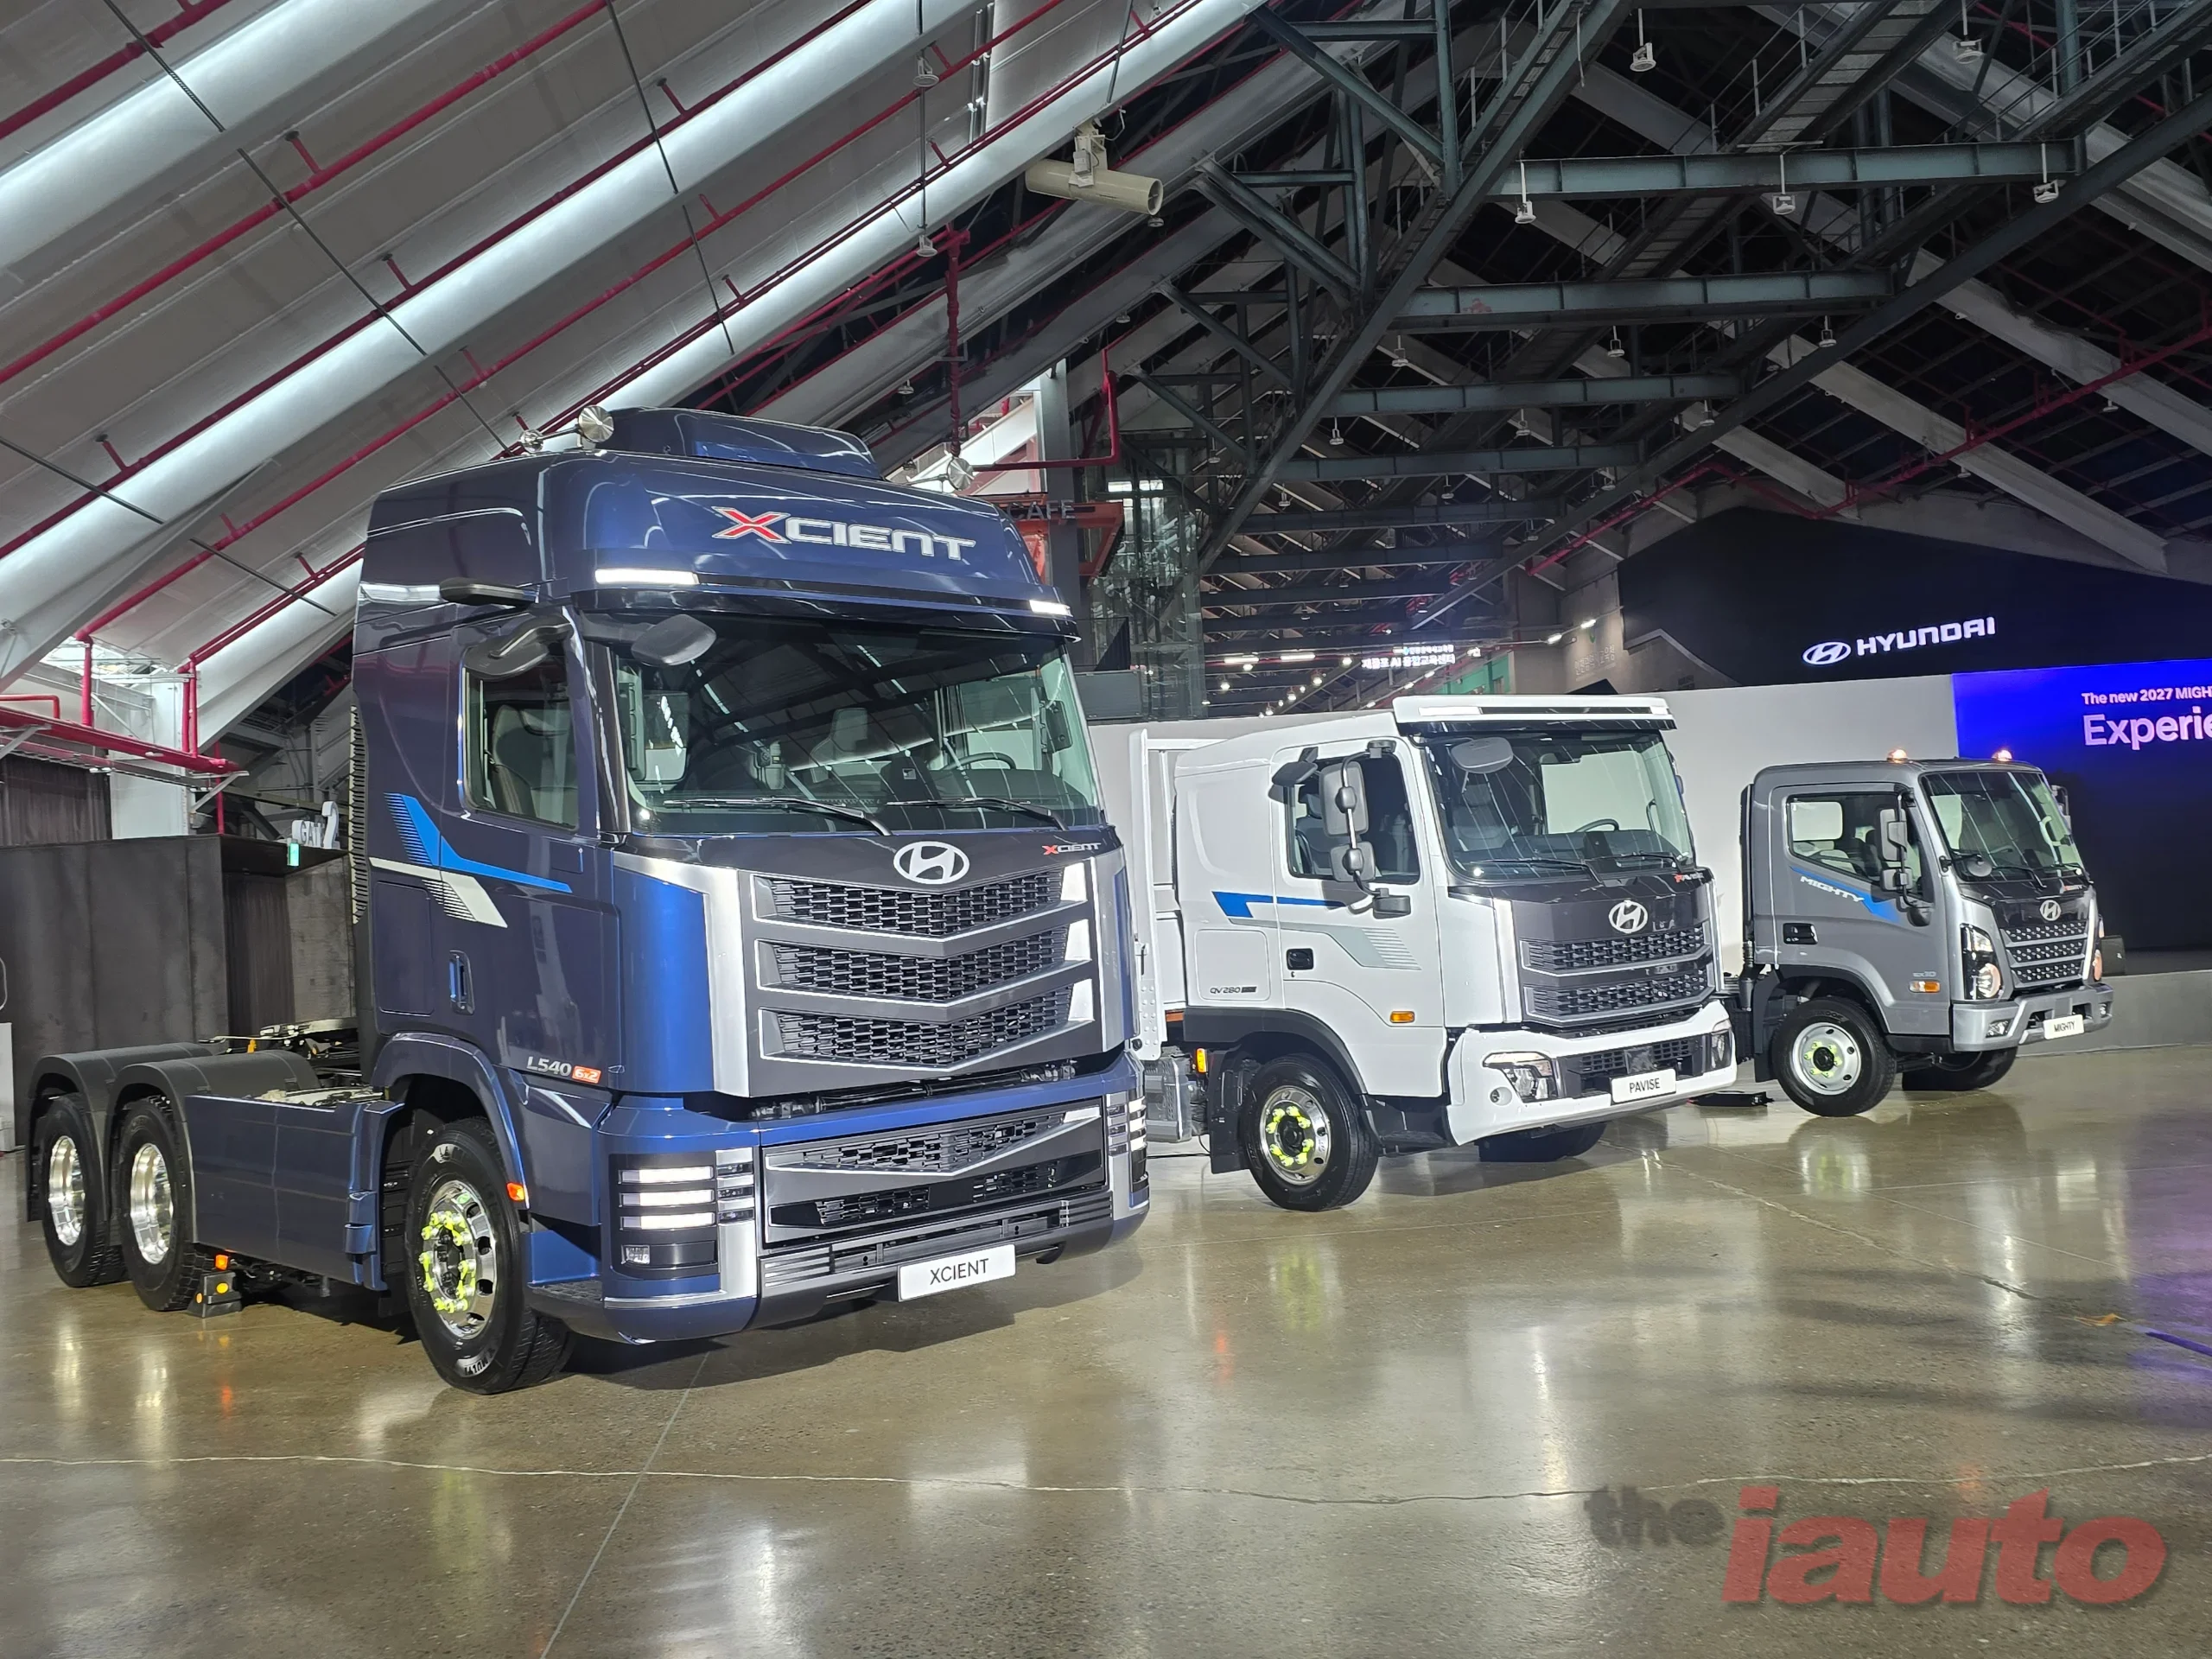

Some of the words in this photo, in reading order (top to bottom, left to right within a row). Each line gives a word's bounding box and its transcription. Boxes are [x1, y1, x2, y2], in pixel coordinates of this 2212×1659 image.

[711, 505, 976, 560] XCIENT
[1856, 616, 1995, 656] HYUNDAI
[1389, 657, 1402, 668] AI
[2081, 692, 2107, 705] The
[2109, 693, 2139, 703] new
[2139, 688, 2173, 702] 2027
[322, 801, 341, 850] 2
[1800, 875, 1866, 902] MIGHTY
[2054, 1020, 2075, 1033] MIGHTY
[526, 1056, 572, 1077] L540
[574, 1068, 599, 1082] 6x2
[1629, 1077, 1661, 1094] PAVISE
[930, 1258, 989, 1286] XCIENT
